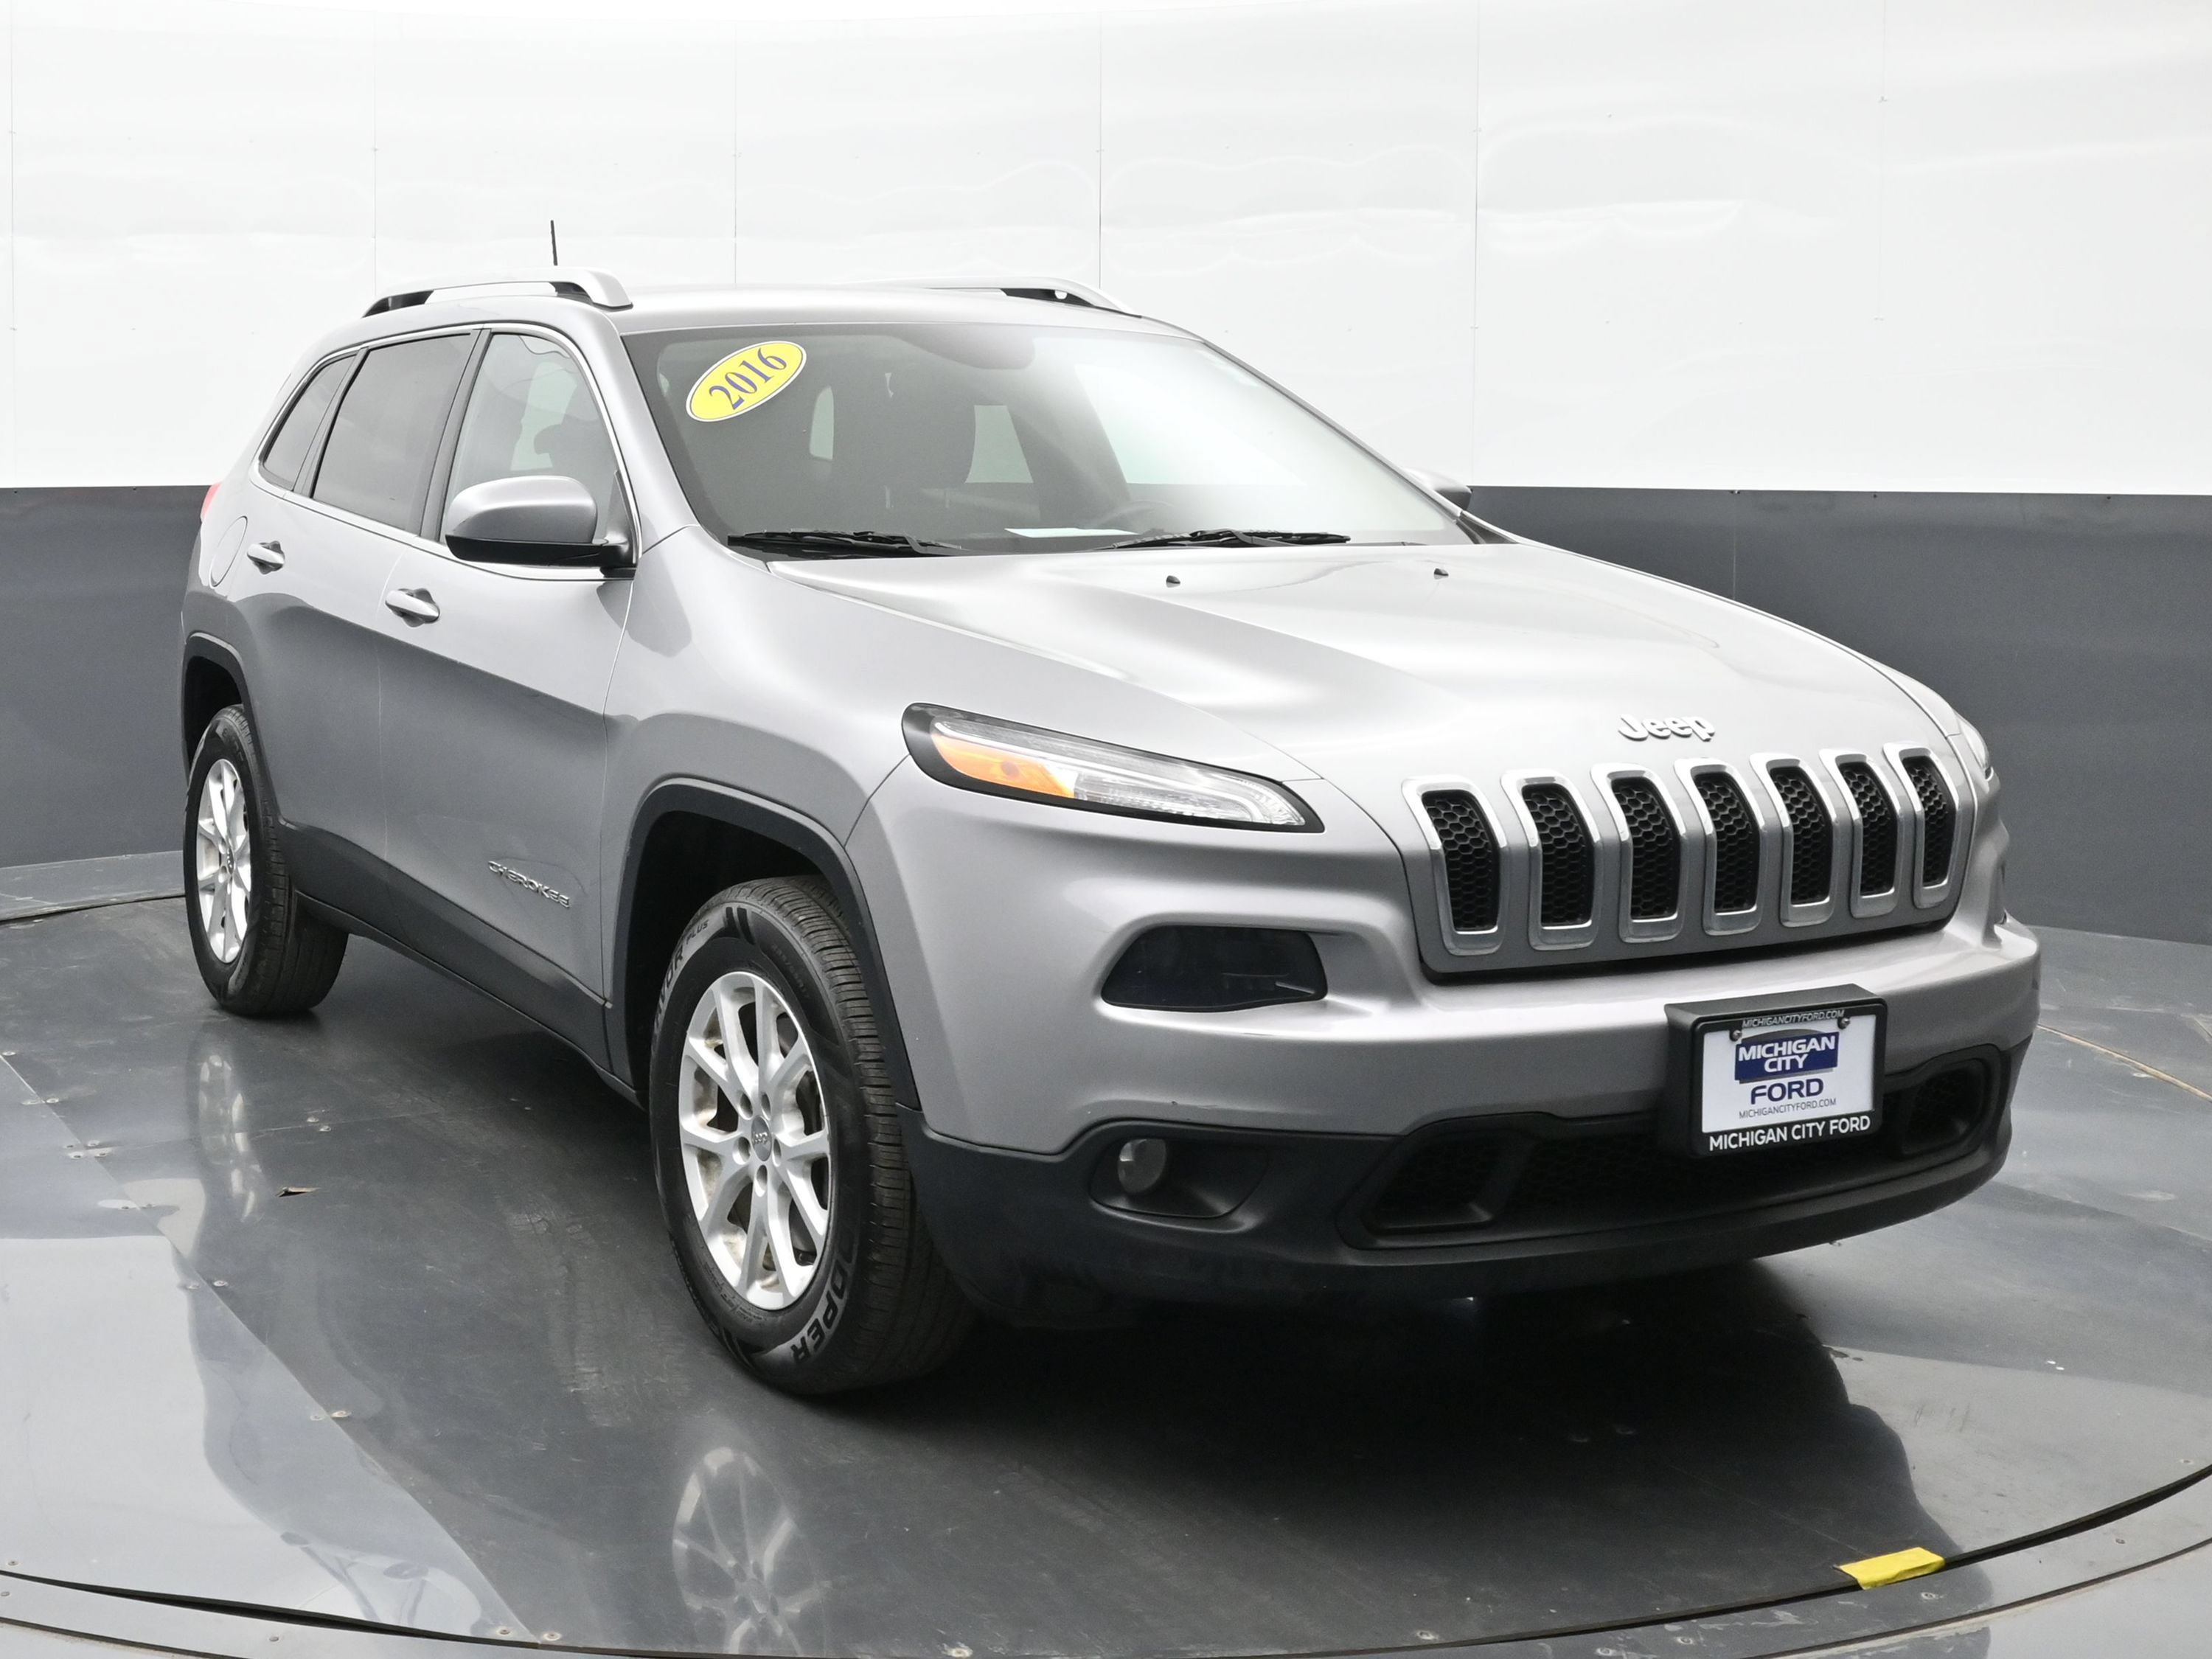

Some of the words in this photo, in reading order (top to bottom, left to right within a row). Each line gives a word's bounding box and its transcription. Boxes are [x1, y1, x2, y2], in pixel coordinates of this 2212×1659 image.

[709, 348, 787, 410] 2016
[1618, 714, 1716, 742] Jeep
[488, 860, 570, 909] CHEROKEE
[1742, 1009, 1845, 1028] MICHIGANCITYFORD.COM
[1738, 1035, 1836, 1062] MICHIGAN
[1764, 1054, 1809, 1073] CITY
[1750, 1078, 1824, 1105] FORD
[1739, 1098, 1837, 1119] MICHIGANCITYFORD.COM
[1709, 1127, 1788, 1152] MICHIGAN
[1791, 1121, 1826, 1141] CITY
[1829, 1115, 1871, 1135] FORD
